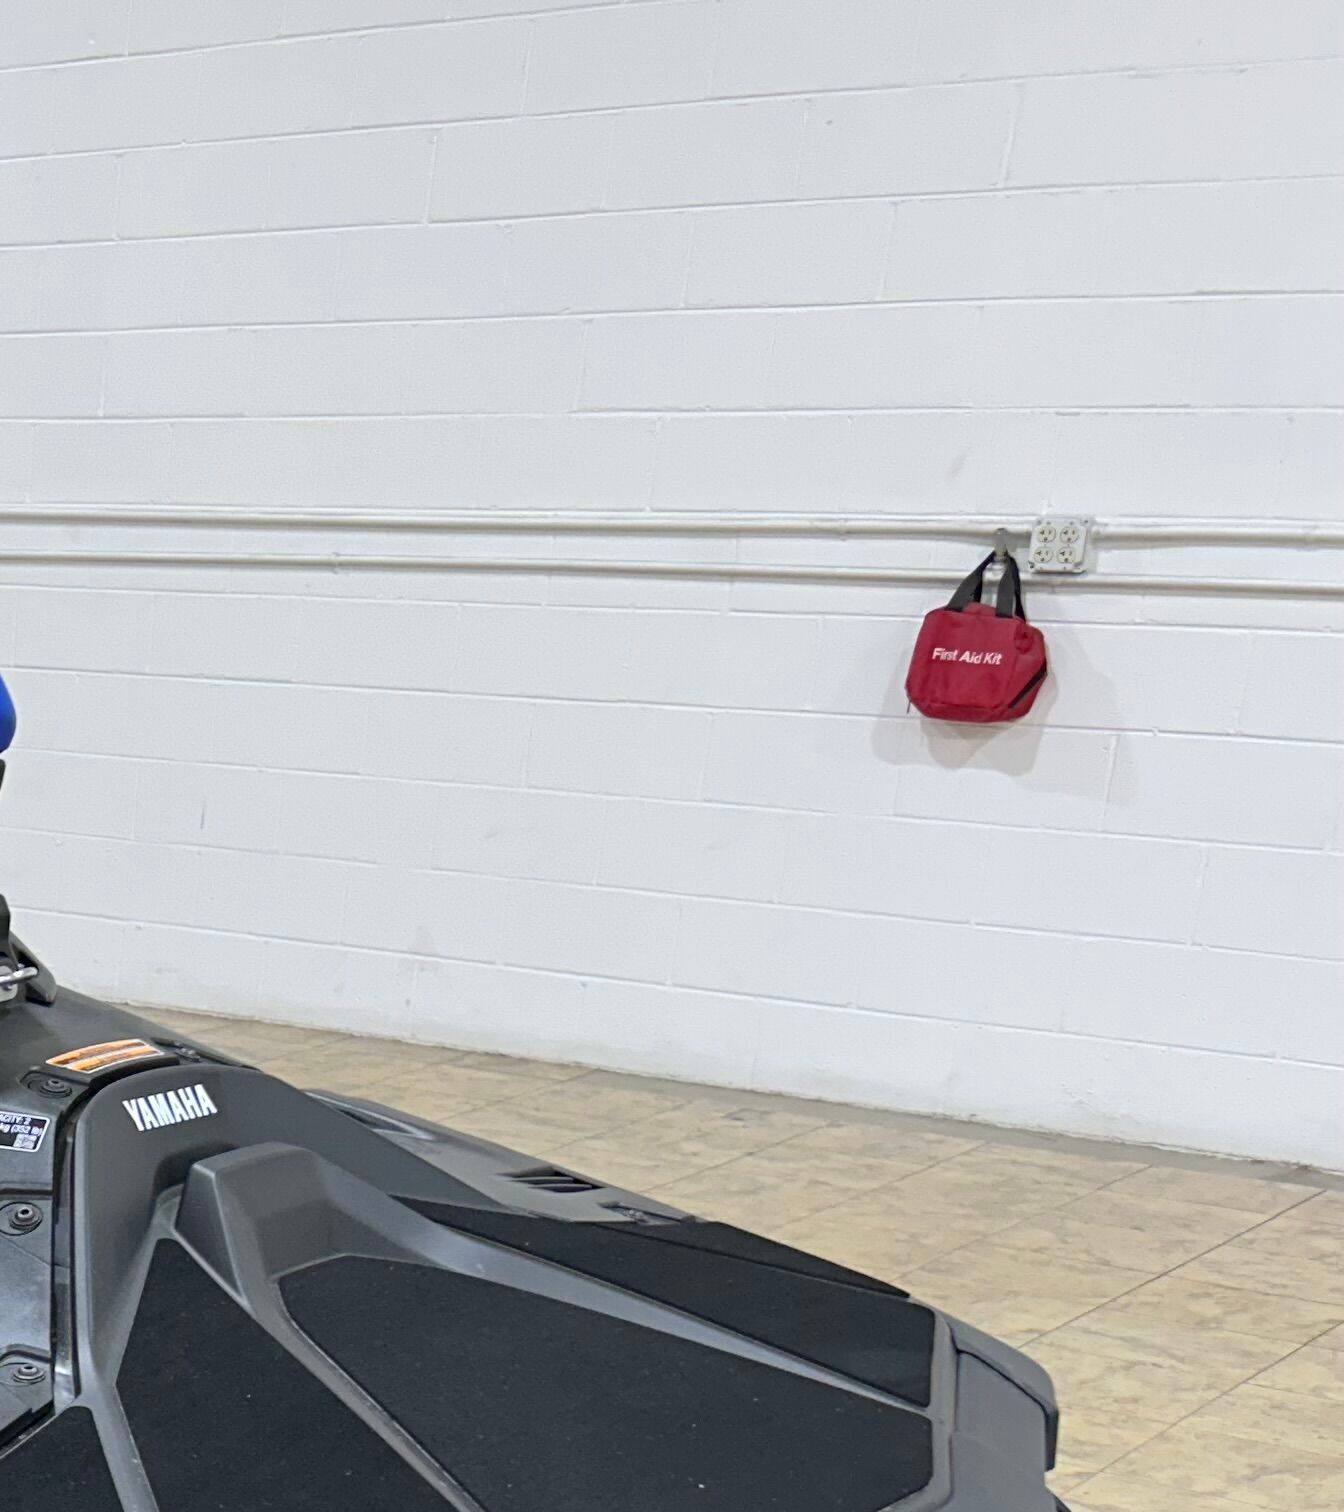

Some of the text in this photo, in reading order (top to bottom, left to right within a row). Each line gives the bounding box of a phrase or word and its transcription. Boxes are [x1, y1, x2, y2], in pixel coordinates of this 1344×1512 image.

[932, 647, 1003, 665] First Aid Kit
[122, 1083, 218, 1132] YAMAHA
